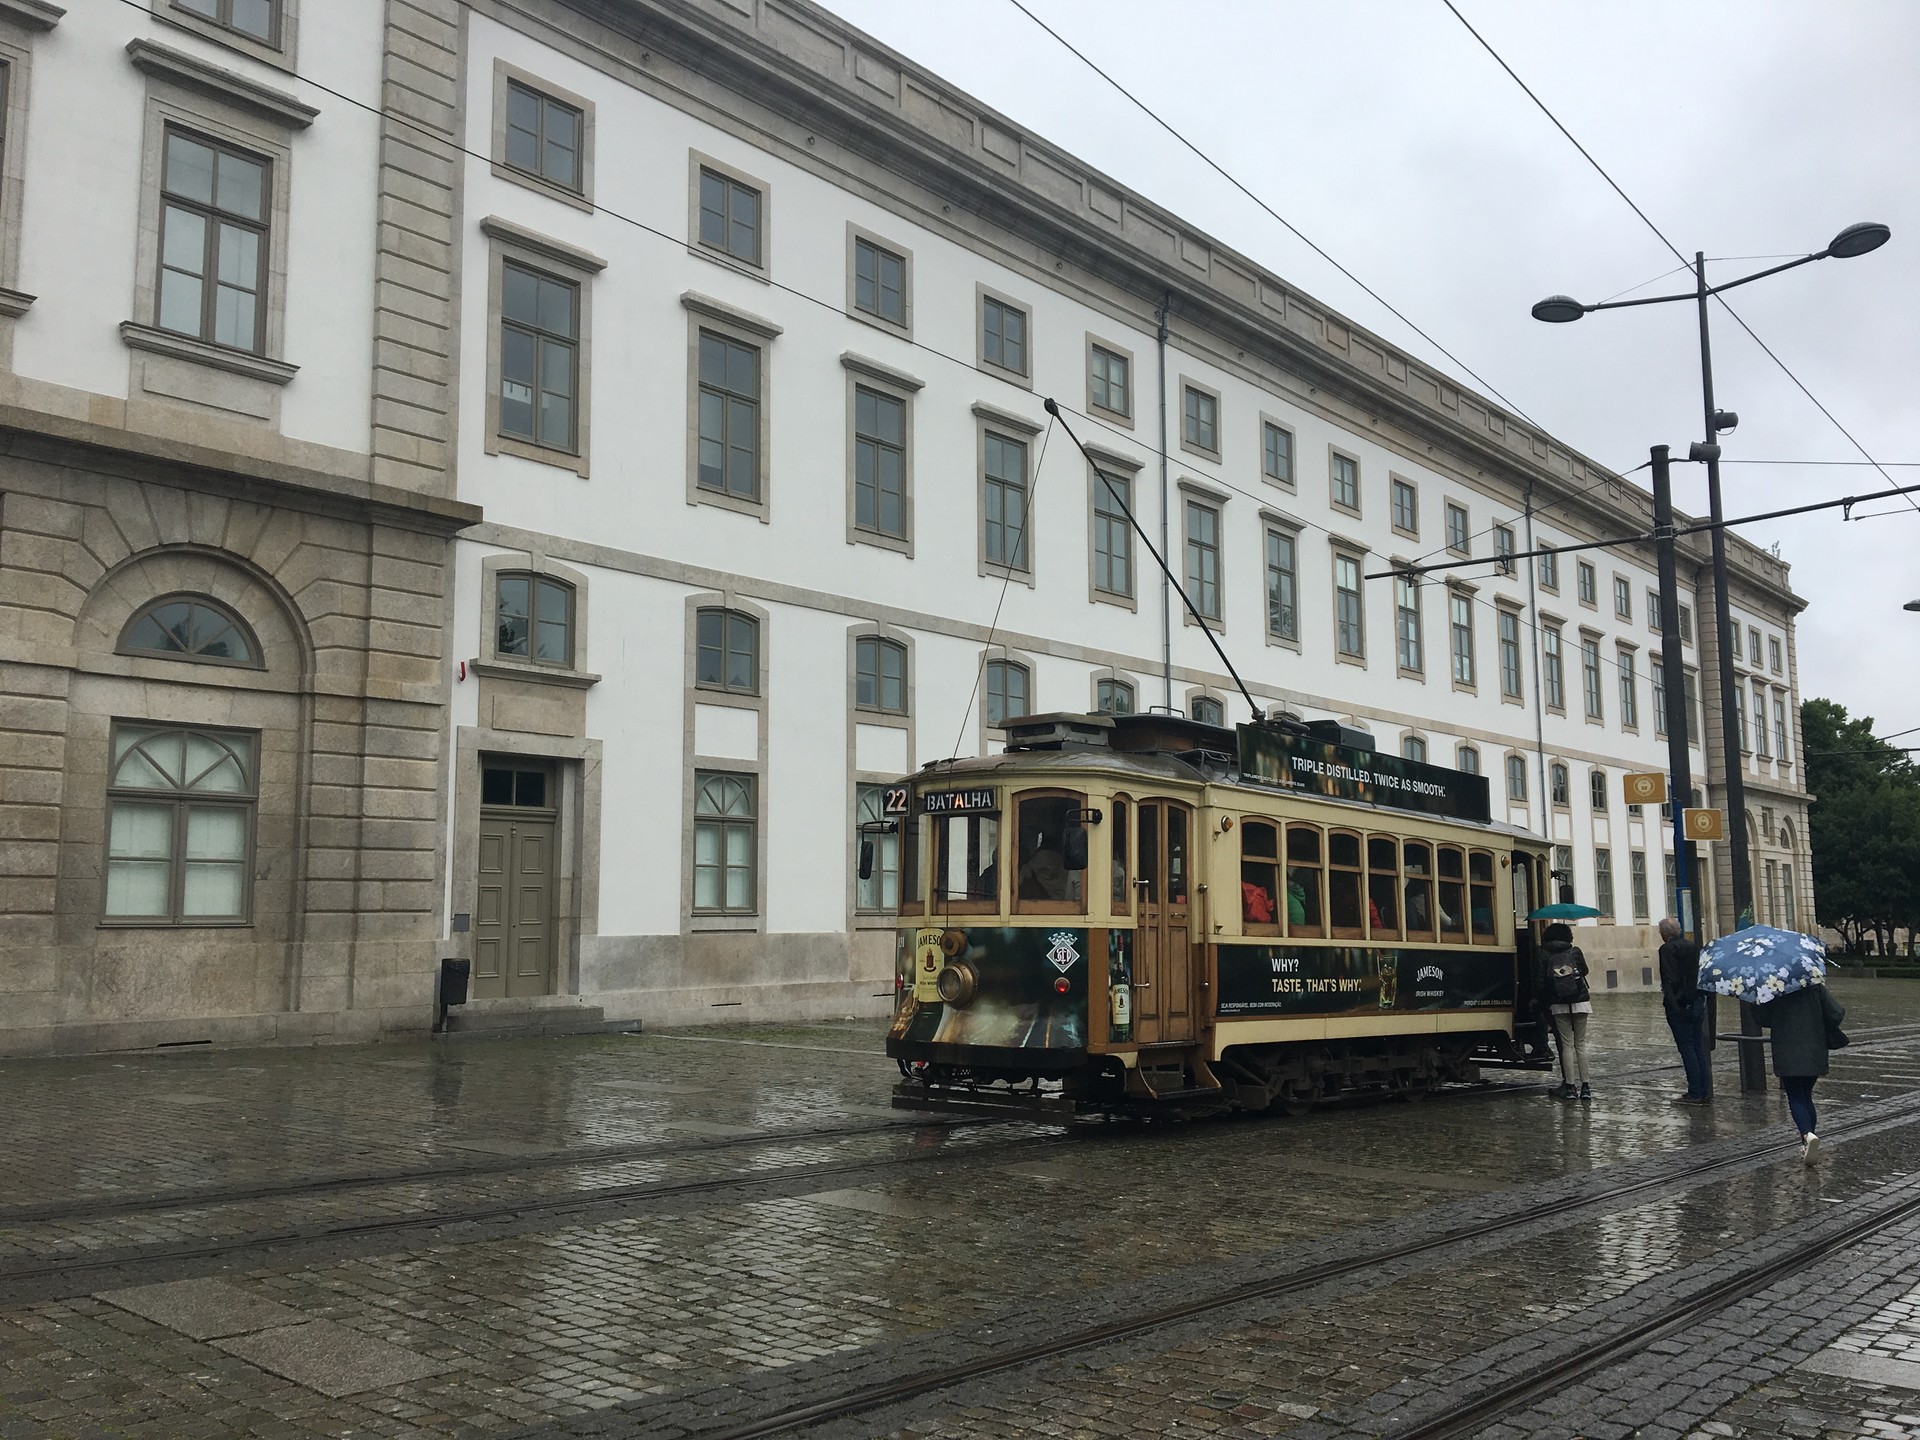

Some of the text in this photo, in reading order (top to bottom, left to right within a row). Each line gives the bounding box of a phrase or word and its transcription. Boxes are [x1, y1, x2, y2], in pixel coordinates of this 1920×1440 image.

[1292, 756, 1325, 775] TRIPLE
[1326, 763, 1373, 784] DISTILLED.
[1373, 772, 1400, 789] TWICE
[1401, 778, 1411, 791] AS
[886, 789, 907, 812] 22
[927, 791, 992, 811] BATALHA
[917, 934, 941, 949] JAMESO
[1271, 958, 1299, 972] WHY?
[1416, 965, 1444, 982] JAMESON
[1272, 979, 1304, 994] TASTE,
[1306, 979, 1337, 992] THAT'S
